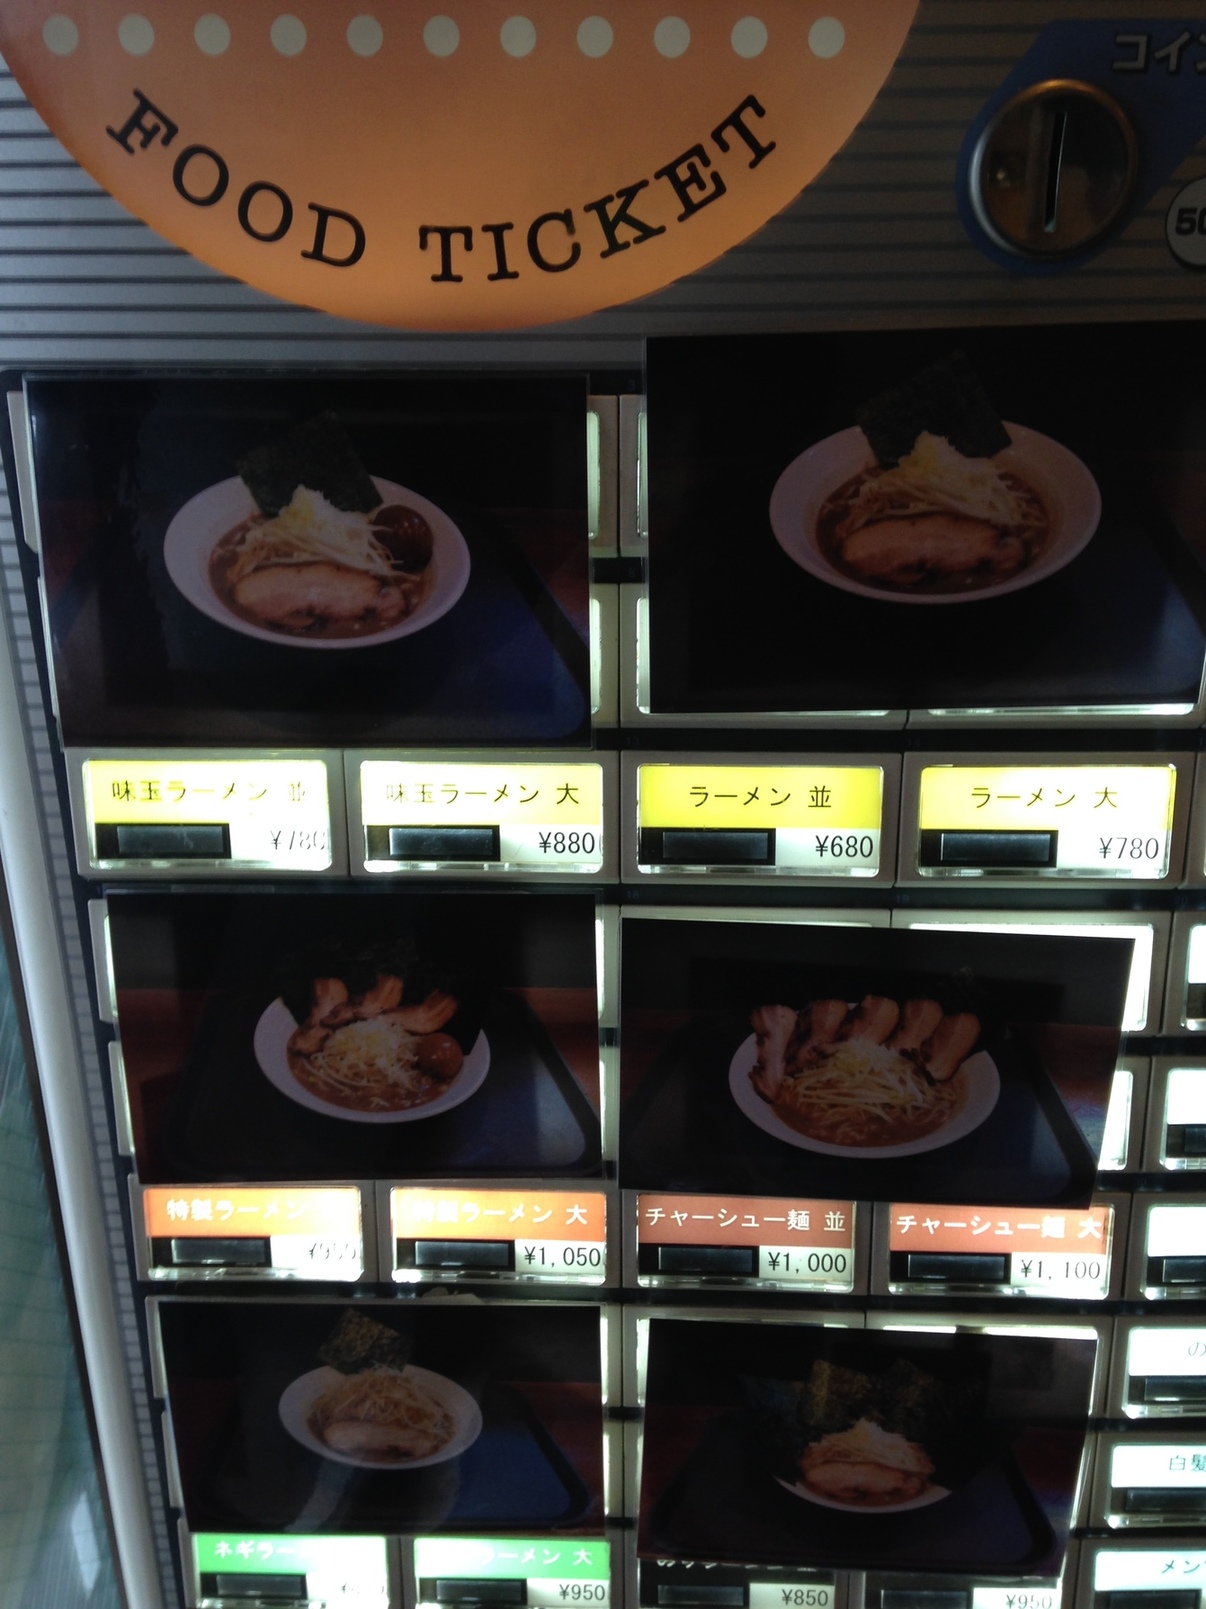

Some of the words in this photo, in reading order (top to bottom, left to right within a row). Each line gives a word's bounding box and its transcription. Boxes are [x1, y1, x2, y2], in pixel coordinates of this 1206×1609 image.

[105, 89, 367, 268] FOOD
[418, 94, 777, 283] TICKET
[111, 779, 268, 802] 味玉ラーメン
[386, 783, 539, 804] 味玉ラーメン
[556, 783, 580, 804] 大
[690, 786, 791, 807] ラーメン
[808, 785, 832, 808] 並
[971, 787, 1076, 809] ラーメン
[1094, 787, 1118, 809] 大
[538, 831, 596, 854] ¥880
[815, 834, 874, 858] ¥680
[1098, 837, 1160, 859] ¥780
[565, 1203, 588, 1225] 大
[645, 1207, 810, 1231] チャーシュー麺
[823, 1210, 846, 1232] 並
[1077, 1216, 1103, 1239] 大
[524, 1245, 600, 1268] ¥1,050
[768, 1251, 847, 1274] ¥1,000
[1020, 1259, 1101, 1281] ¥1,100
[573, 1548, 593, 1567] 大
[1161, 1559, 1206, 1574] メン
[559, 1584, 606, 1601] ¥950
[782, 1588, 829, 1607] ¥850
[1006, 1593, 1053, 1609] ¥950
